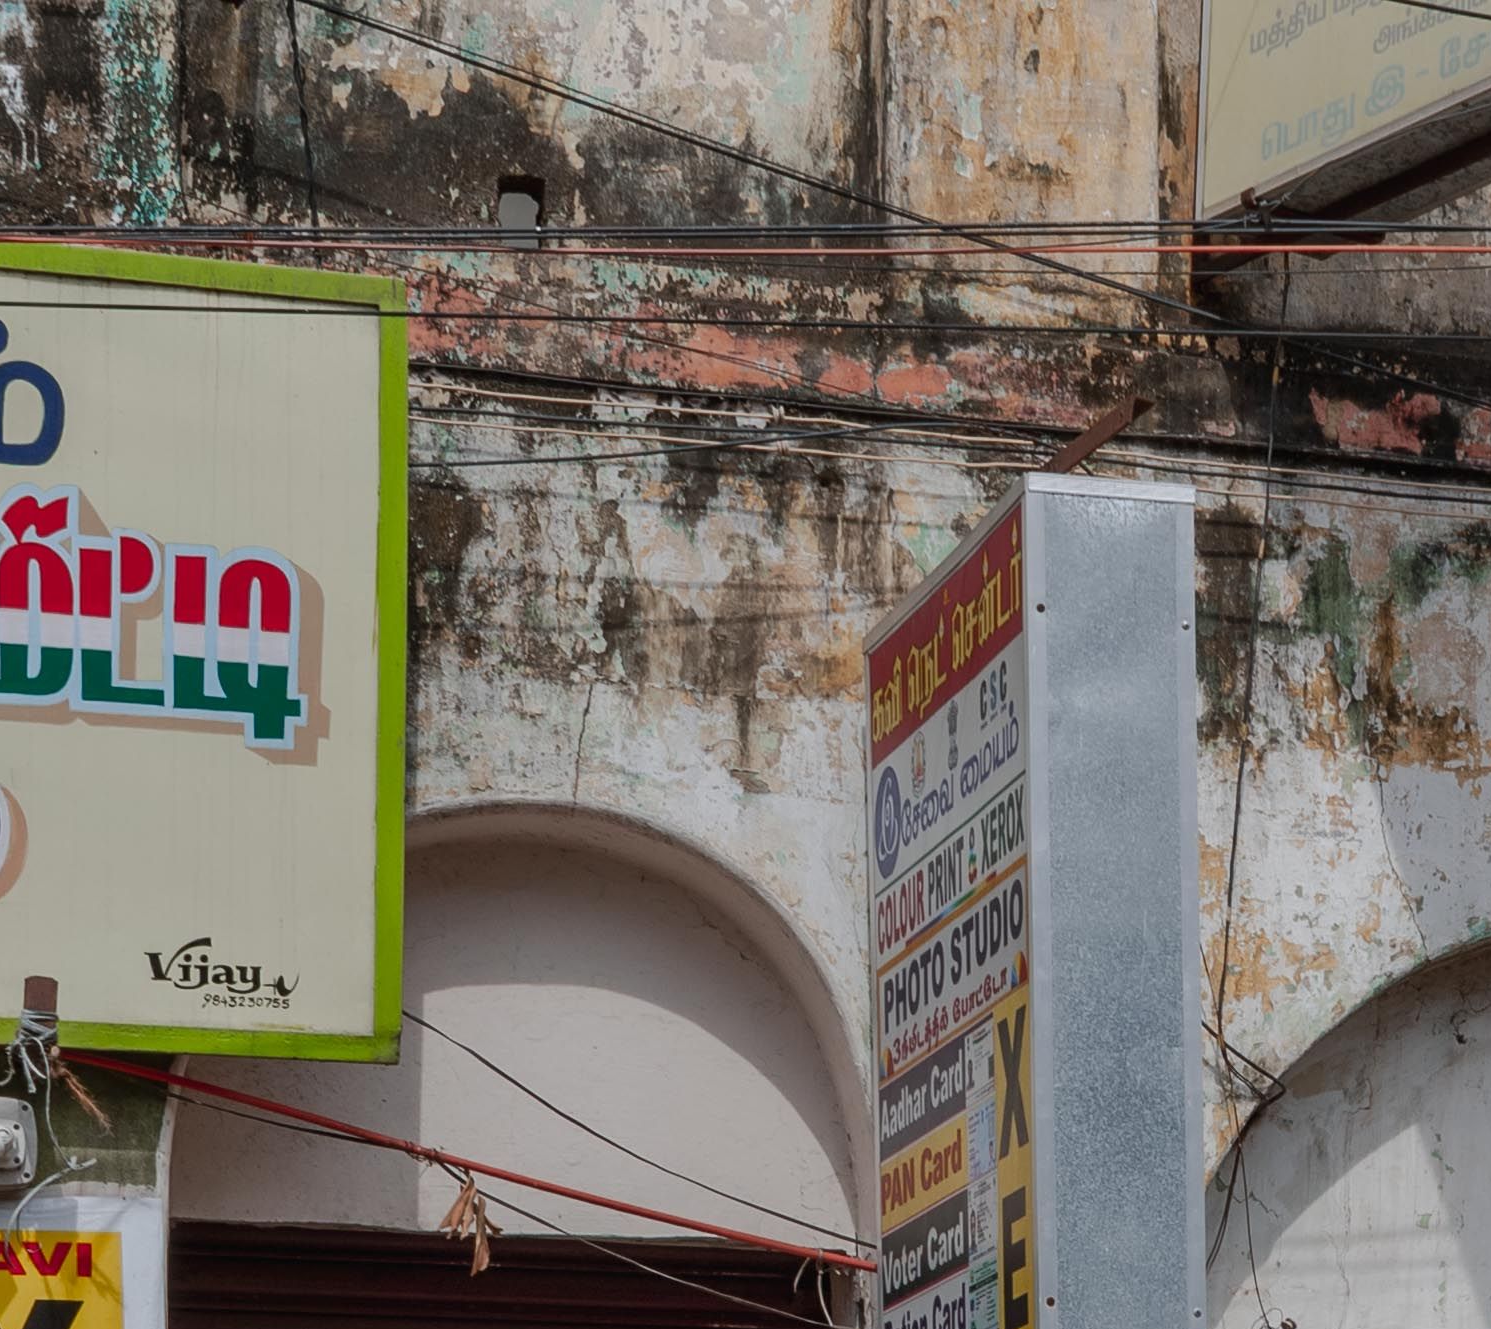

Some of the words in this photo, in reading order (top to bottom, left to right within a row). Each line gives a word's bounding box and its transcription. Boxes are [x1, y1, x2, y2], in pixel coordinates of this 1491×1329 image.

[980, 659, 1008, 721] CSC
[877, 869, 925, 956] COLOUR
[927, 834, 965, 917] PRINT
[981, 783, 1025, 875] XEROX
[144, 937, 262, 994] Vijay
[884, 940, 945, 1036] PHOTO
[950, 878, 1024, 987] STUDIO
[880, 1079, 928, 1143] Aadhar
[930, 1047, 963, 1110] Card
[880, 1155, 916, 1217] PAN
[921, 1127, 963, 1191] Card
[882, 1243, 925, 1296] Voter
[926, 1210, 965, 1272] Card
